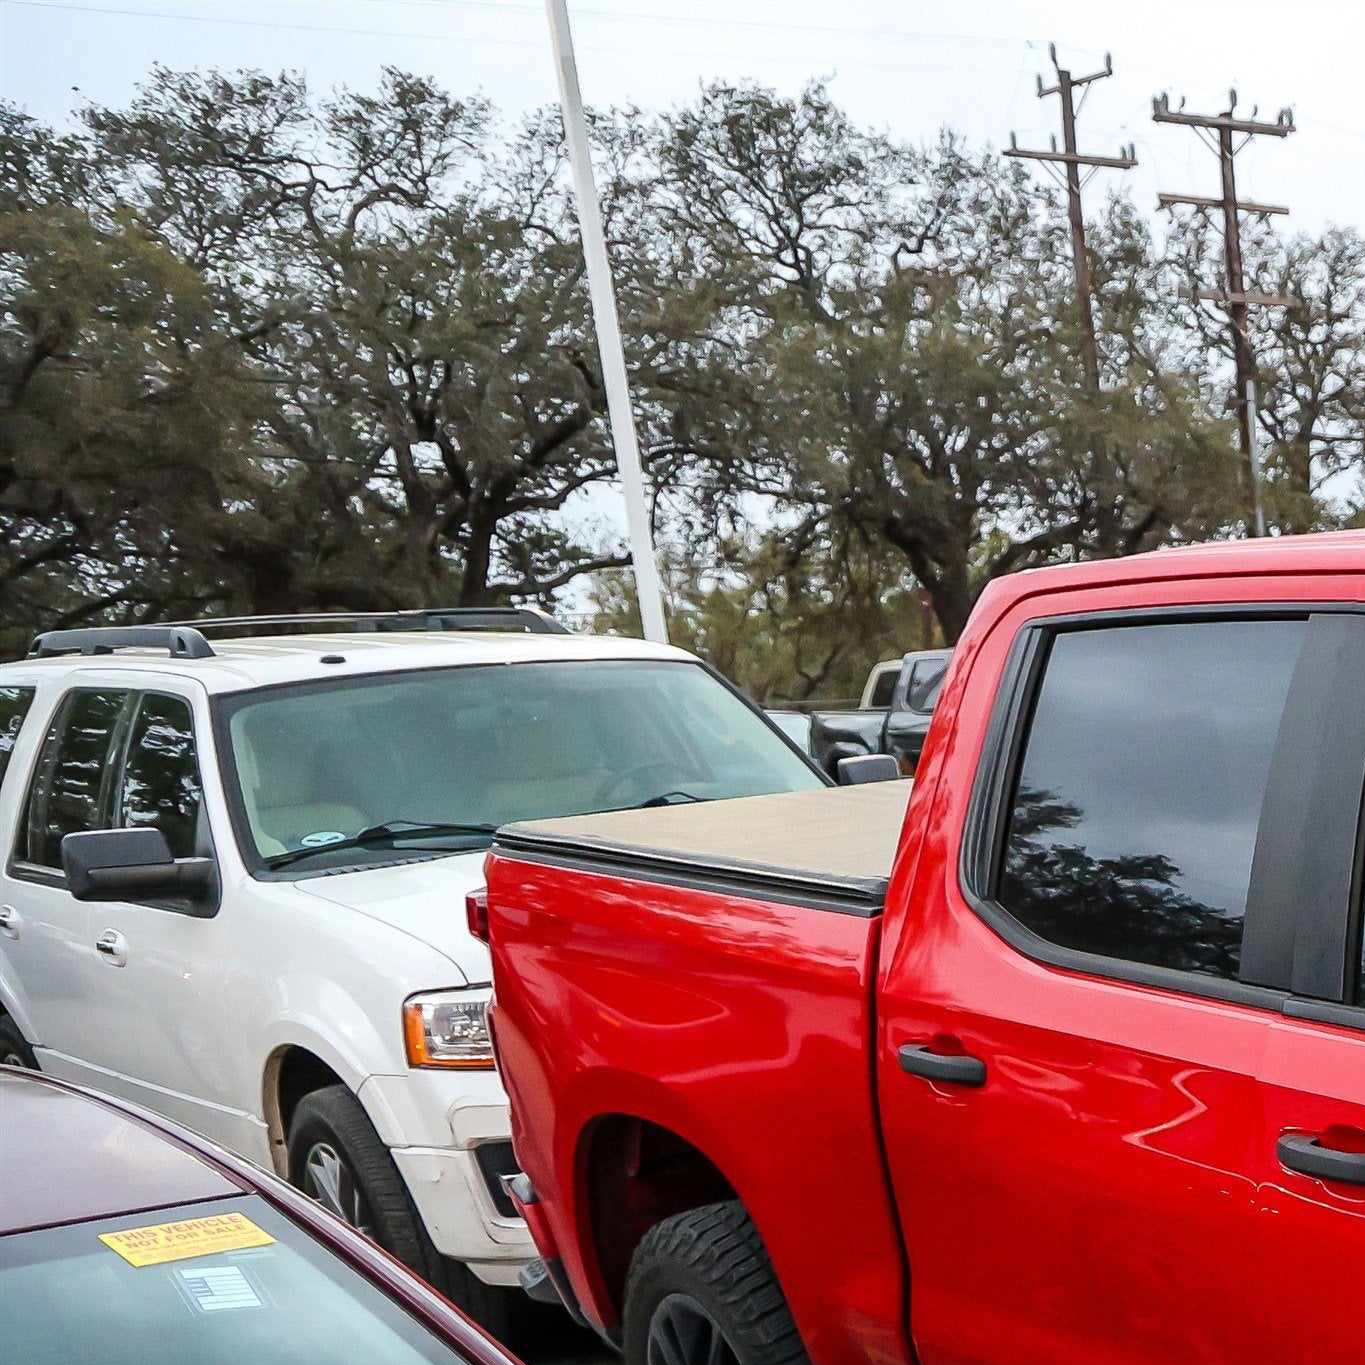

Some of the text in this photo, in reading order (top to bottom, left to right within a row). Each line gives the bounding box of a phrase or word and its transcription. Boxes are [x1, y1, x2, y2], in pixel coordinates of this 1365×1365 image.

[110, 1228, 158, 1243] THIS
[160, 1215, 243, 1235] VEHICLE
[125, 1237, 160, 1250] NOT
[164, 1229, 200, 1243] FOR
[203, 1223, 248, 1236] SALE
